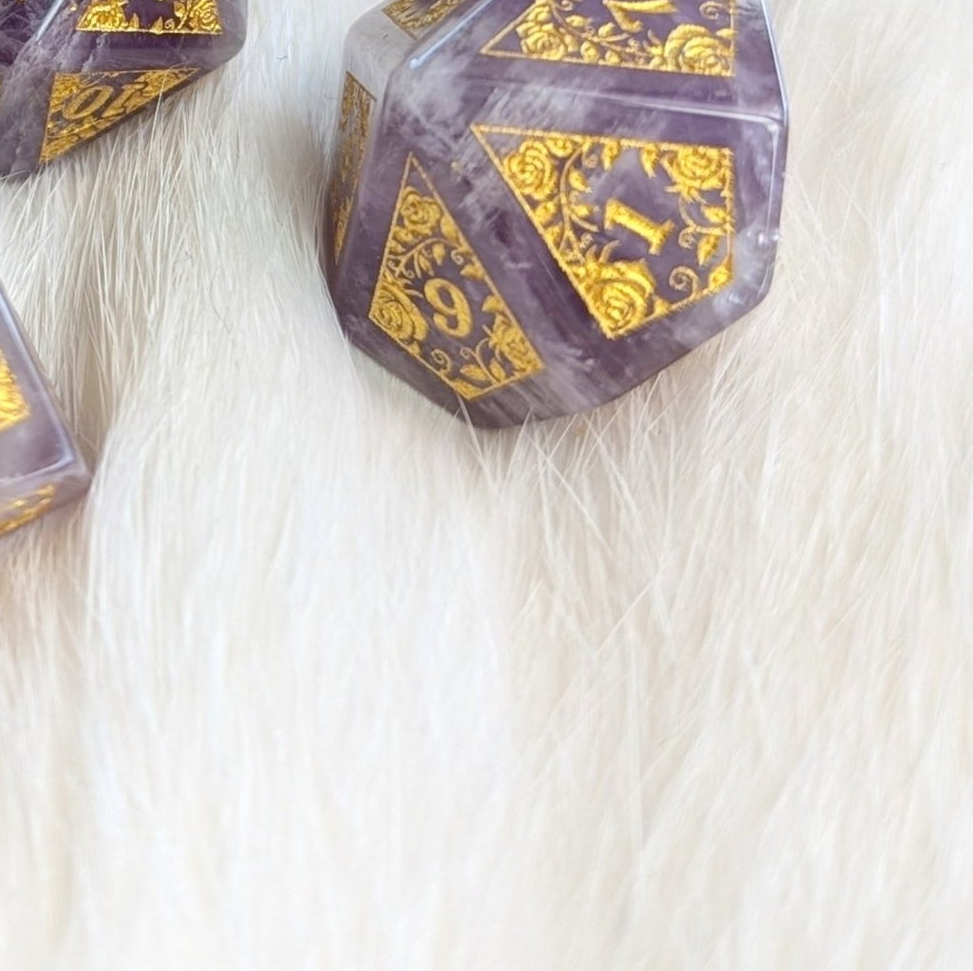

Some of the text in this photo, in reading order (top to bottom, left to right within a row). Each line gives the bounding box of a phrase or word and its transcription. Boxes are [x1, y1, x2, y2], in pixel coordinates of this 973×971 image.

[62, 83, 146, 120] 10
[604, 199, 676, 255] 1
[423, 277, 473, 337] 9
